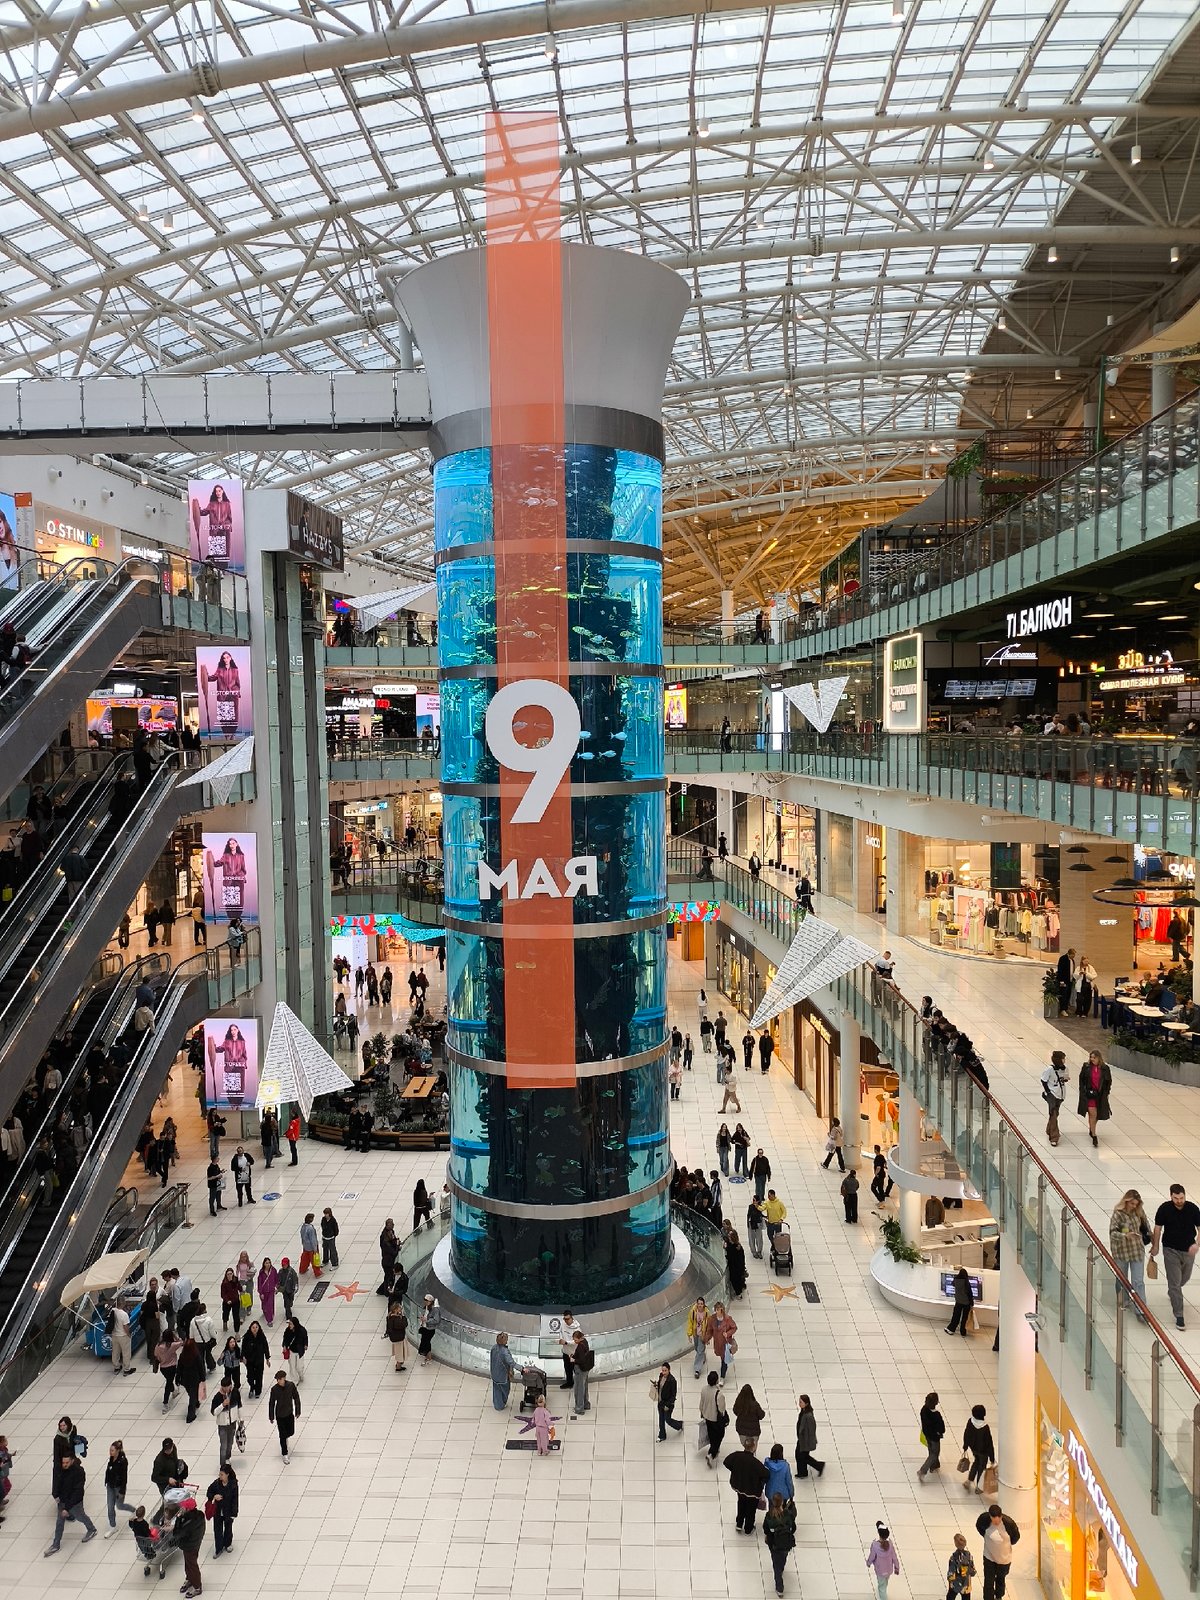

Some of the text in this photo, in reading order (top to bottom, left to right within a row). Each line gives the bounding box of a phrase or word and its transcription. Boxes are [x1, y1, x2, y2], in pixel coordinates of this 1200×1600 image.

[86, 532, 104, 548] kids
[1020, 596, 1072, 636] БАЛКОН
[1120, 676, 1159, 689] ПОЛЕЗНАЯ
[1161, 674, 1185, 685] КУХНЯ
[485, 679, 581, 824] 9
[478, 856, 599, 900] МАЯ
